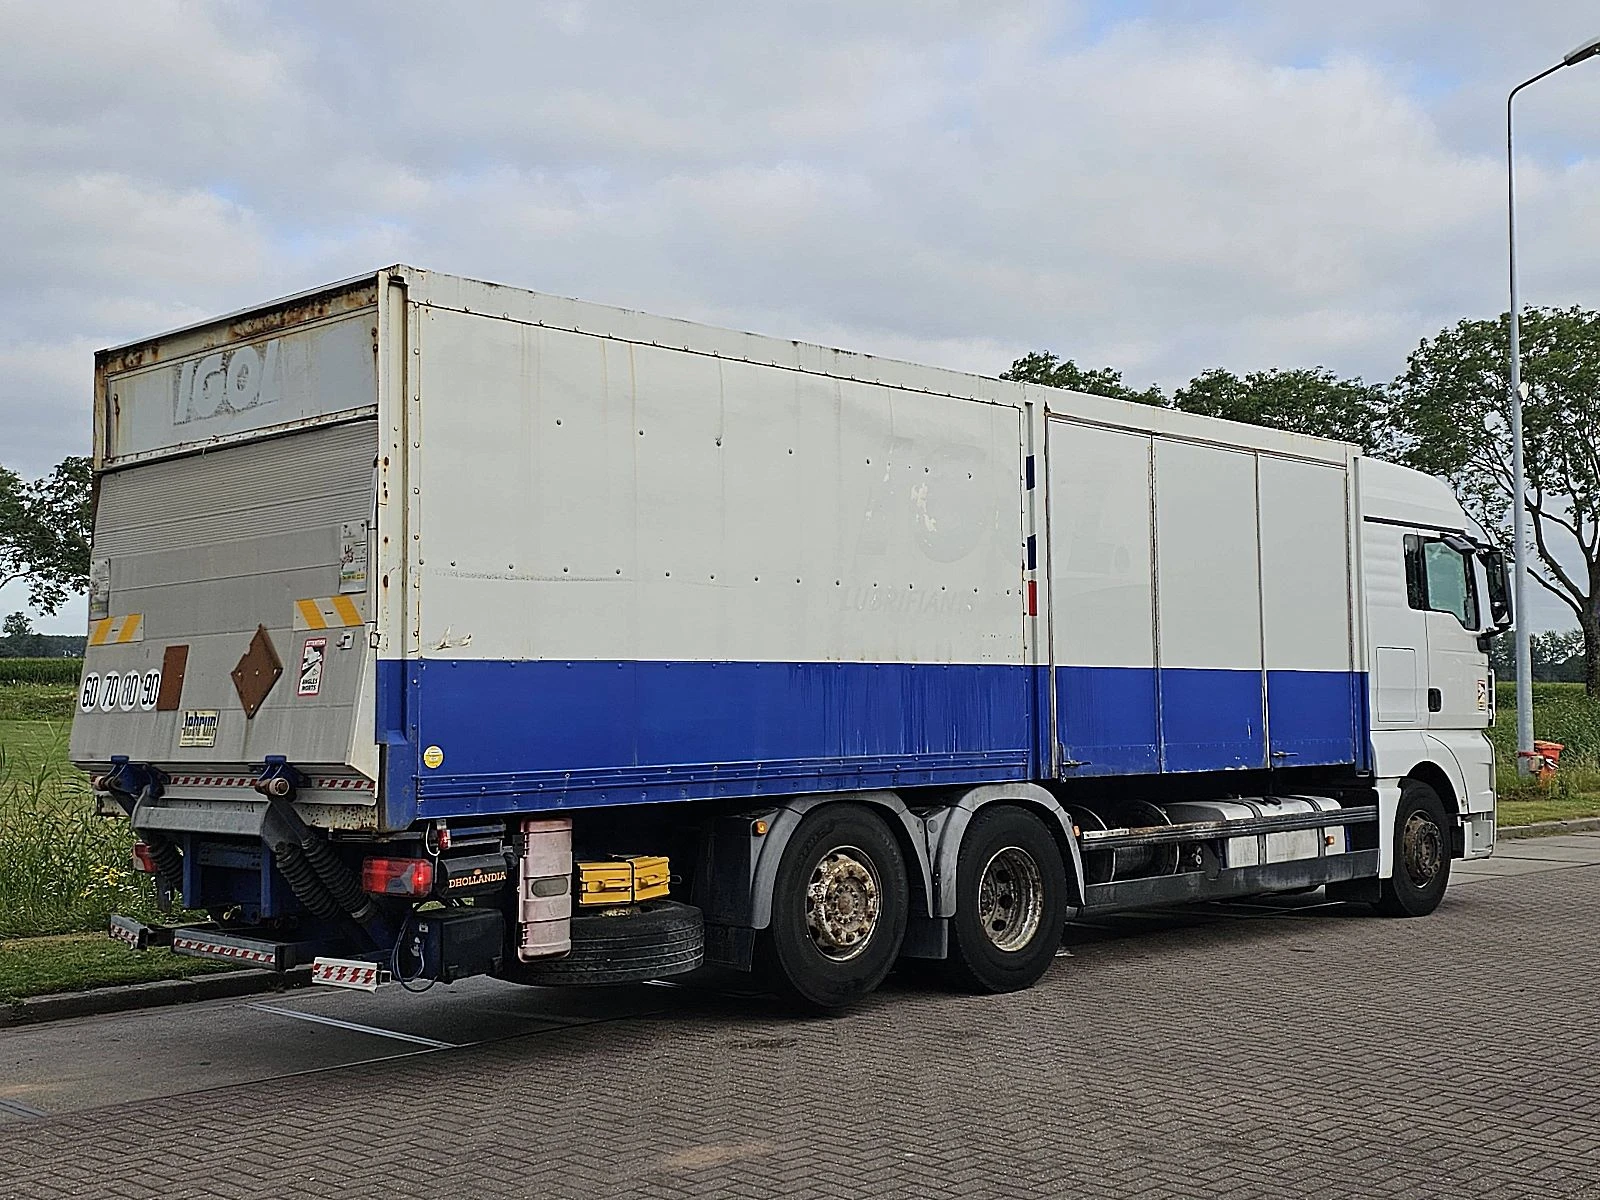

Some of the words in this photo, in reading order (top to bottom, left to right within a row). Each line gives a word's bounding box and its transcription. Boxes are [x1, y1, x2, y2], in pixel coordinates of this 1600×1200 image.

[82, 677, 99, 708] 60
[102, 676, 119, 707] 70
[122, 674, 139, 706] 80
[141, 673, 160, 705] 90
[448, 871, 507, 889] DHOLLANDIA
